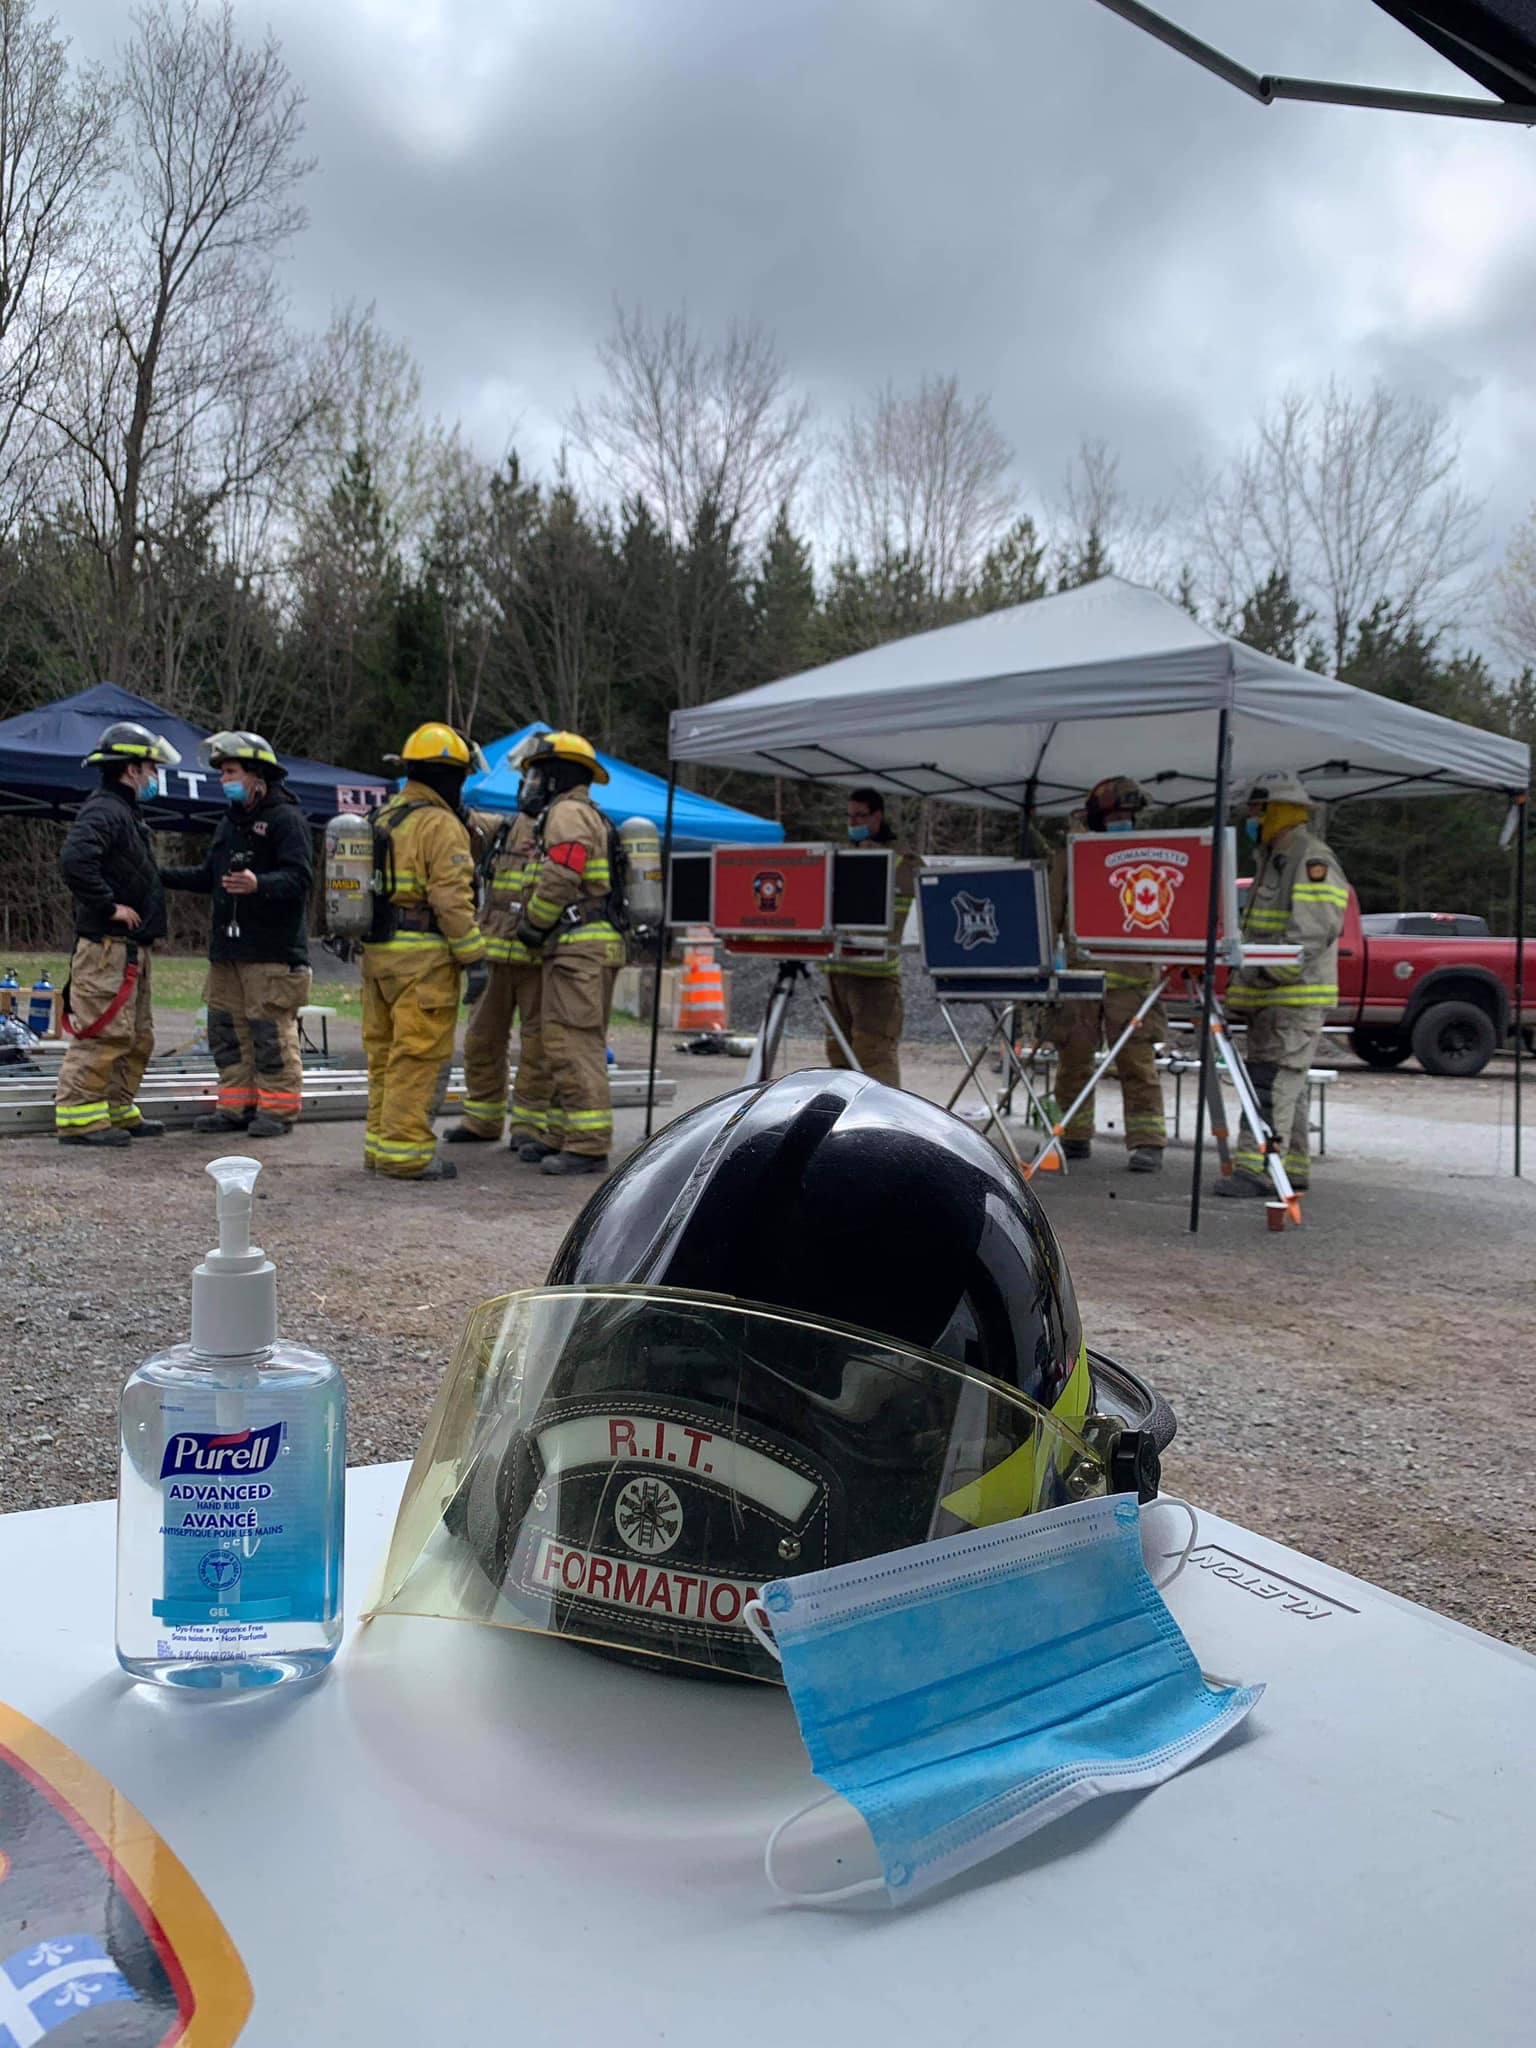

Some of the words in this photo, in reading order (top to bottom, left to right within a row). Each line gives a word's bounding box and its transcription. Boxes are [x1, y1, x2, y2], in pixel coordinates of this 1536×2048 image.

[337, 786, 386, 806] RIT
[174, 1436, 270, 1469] Purell
[608, 1419, 713, 1474] R.I.T.
[169, 1484, 272, 1501] ADVANCED
[197, 1502, 221, 1510] HAND
[224, 1502, 240, 1510] RUB
[182, 1509, 257, 1528] AVANCÉ
[159, 1526, 211, 1538] ANTISEPTIQUE
[214, 1529, 237, 1538] POUR
[255, 1525, 284, 1536] MAINS
[209, 1607, 230, 1617] GEL
[212, 1626, 246, 1635] Fragrance
[248, 1624, 263, 1632] Free
[221, 1634, 237, 1642] Non
